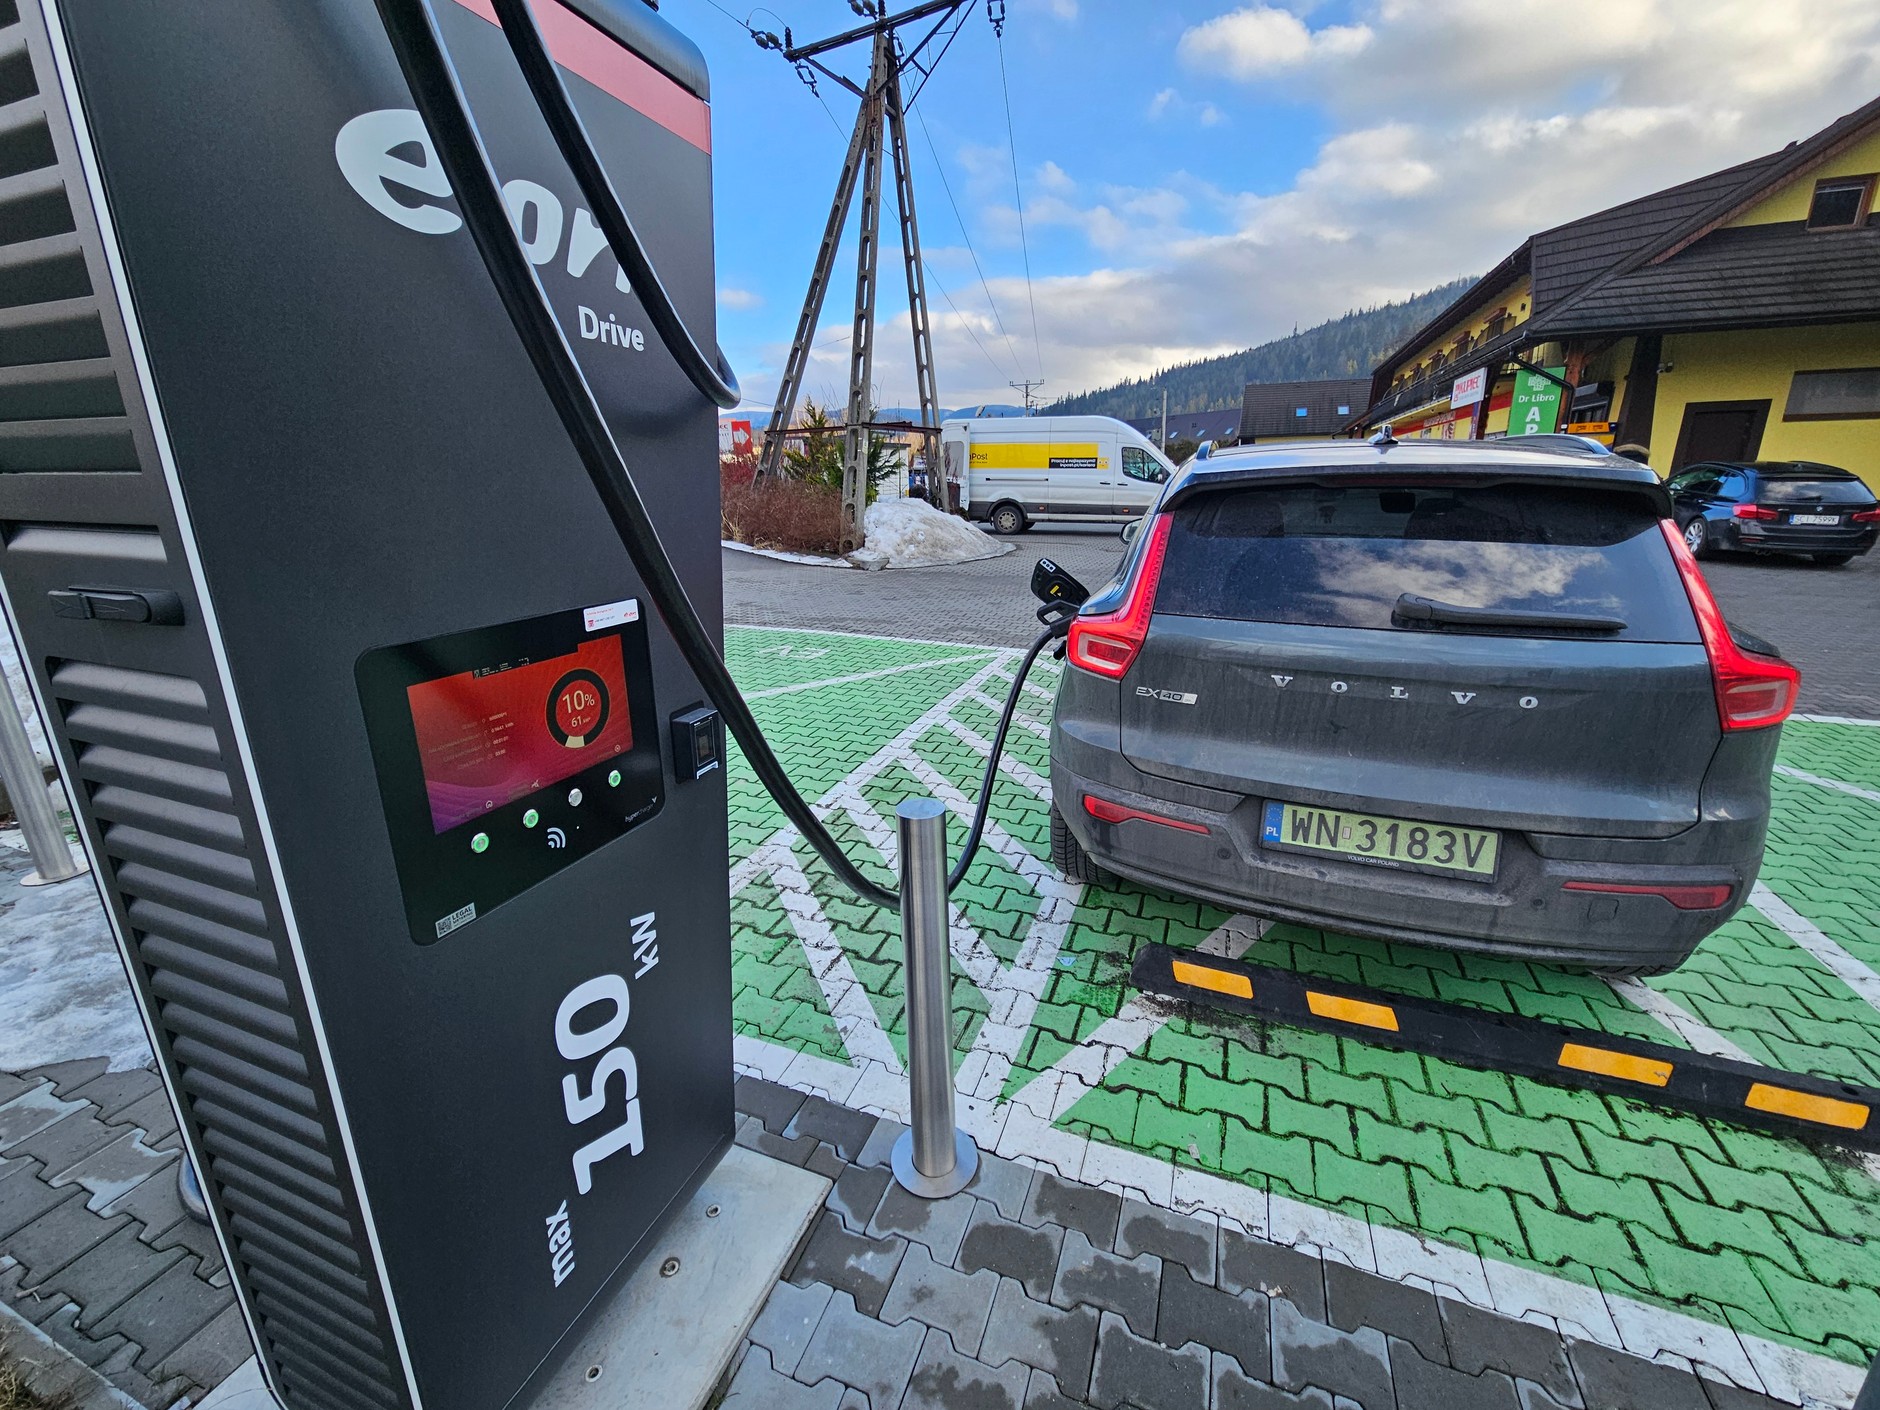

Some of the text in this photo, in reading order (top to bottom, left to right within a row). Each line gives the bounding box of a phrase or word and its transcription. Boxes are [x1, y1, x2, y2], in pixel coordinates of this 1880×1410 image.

[577, 305, 645, 352] Drive
[1518, 394, 1555, 403] Dr Libro
[1136, 686, 1183, 702] EX40
[1271, 674, 1539, 710] VOLVO
[562, 690, 595, 714] 10%
[571, 716, 582, 727] 61
[1266, 826, 1279, 837] PL
[1291, 809, 1488, 868] WN 3183V
[1377, 859, 1399, 867] POLAND
[451, 906, 472, 920] LEGAL
[545, 911, 659, 1288] max 150 kW
